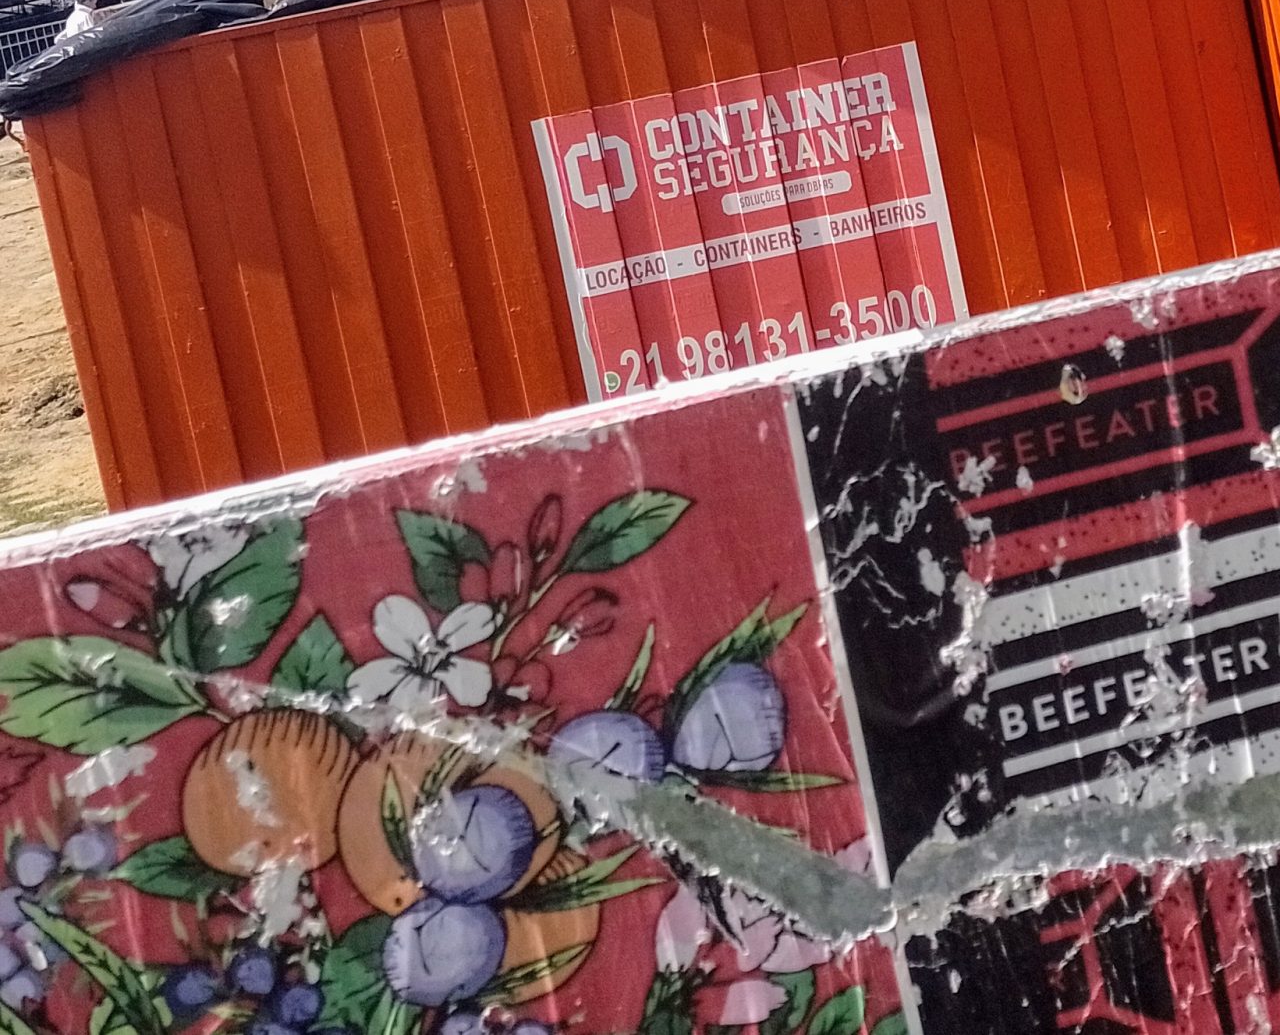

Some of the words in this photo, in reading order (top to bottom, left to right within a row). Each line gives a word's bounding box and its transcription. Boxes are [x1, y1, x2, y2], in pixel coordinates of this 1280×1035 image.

[644, 71, 897, 161] CONTAINER
[652, 114, 904, 200] SEGURANÇA
[740, 189, 780, 208] SOLUÇÕES
[784, 183, 806, 198] PARA
[585, 254, 667, 291] LOCAÇÃO
[693, 226, 803, 268] CONTAINERS
[829, 201, 927, 238] BANHEIROS
[620, 340, 664, 396] 21
[676, 284, 938, 379] 98131-3500
